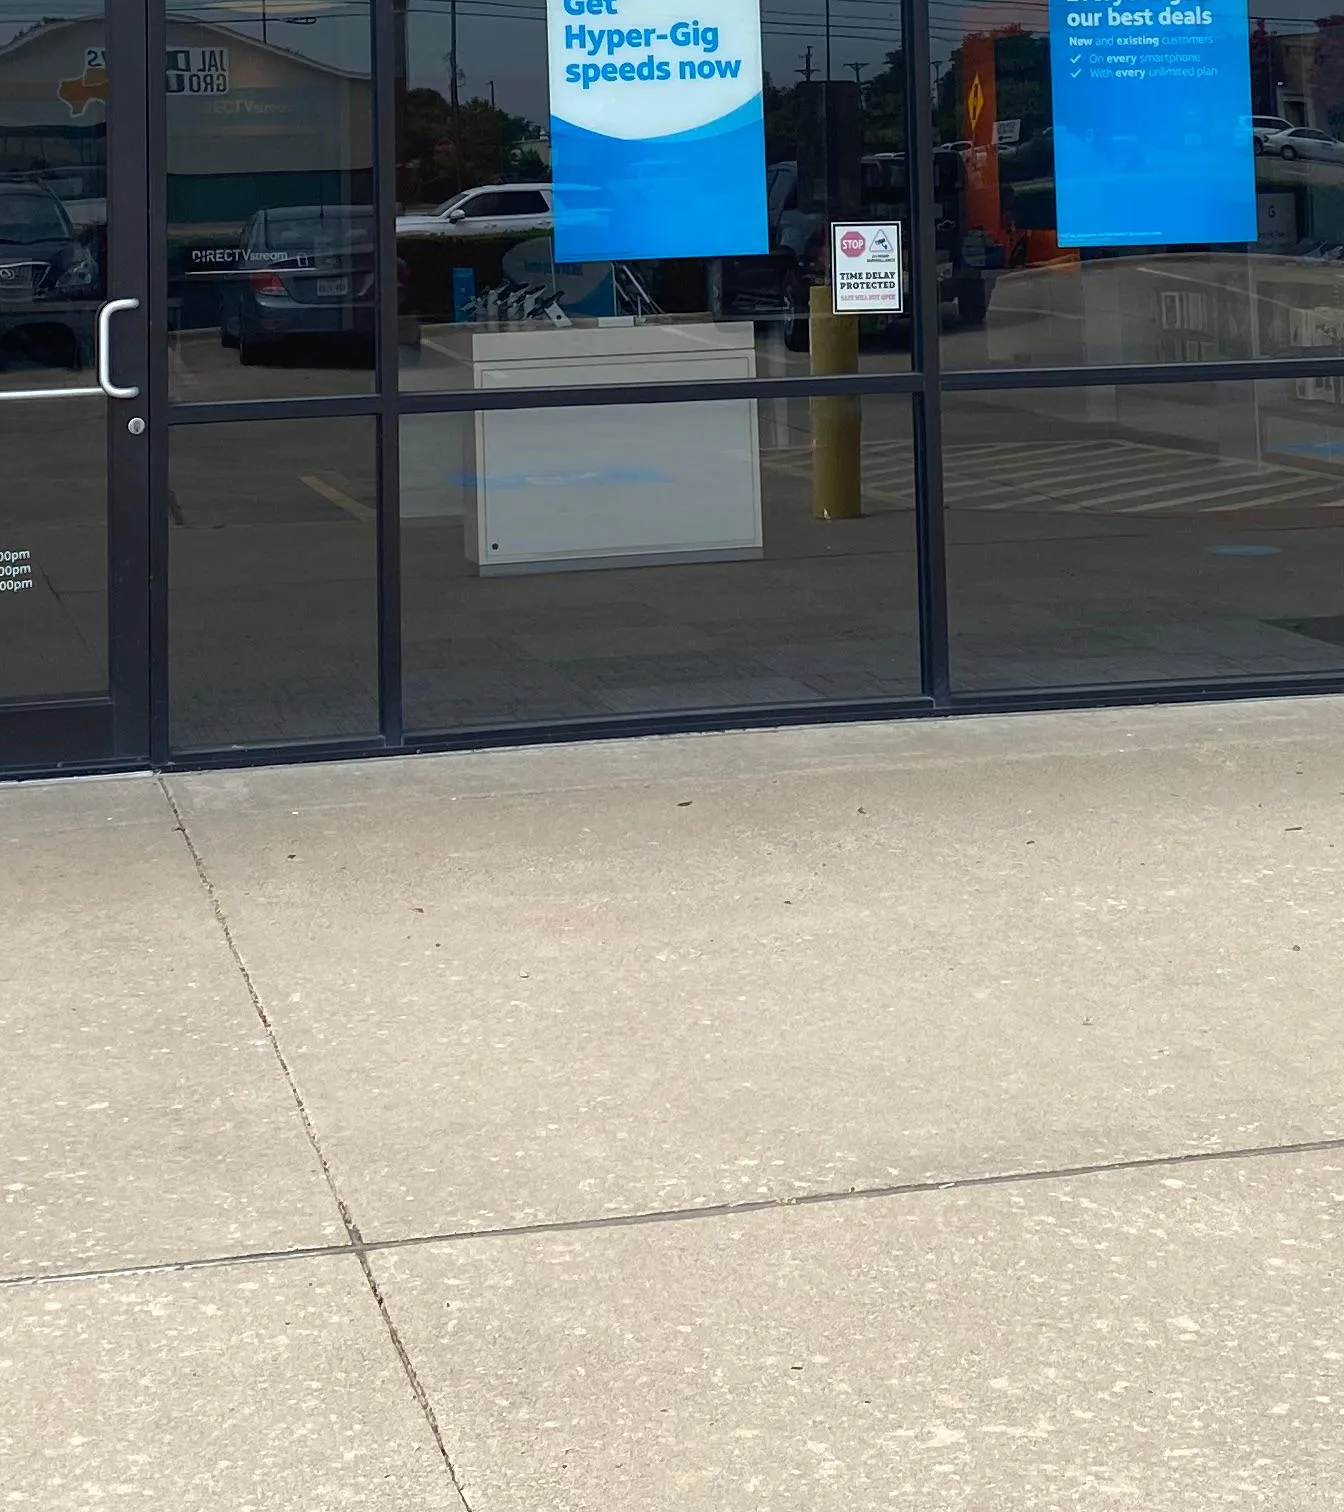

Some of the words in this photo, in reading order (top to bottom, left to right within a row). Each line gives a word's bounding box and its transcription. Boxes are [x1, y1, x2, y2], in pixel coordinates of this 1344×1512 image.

[1066, 11, 1103, 27] our
[1107, 7, 1154, 26] best
[1158, 6, 1212, 26] deals
[564, 20, 719, 57] Hyper-Gig
[1069, 37, 1093, 47] New
[1095, 36, 1114, 46] and
[1116, 35, 1159, 48] existing
[1161, 35, 1214, 45] customers
[1089, 54, 1104, 64] On
[1106, 55, 1137, 66] every
[1139, 53, 1201, 64] smartphone
[565, 54, 671, 90] speeds
[679, 59, 742, 80] now
[1090, 67, 1113, 78] With
[1115, 69, 1145, 80] every
[1149, 67, 1195, 77] unlimited
[1196, 66, 1218, 78] plan
[842, 239, 864, 250] STOP
[839, 272, 863, 280] TIME
[865, 271, 896, 280] DELAY
[839, 281, 896, 290] PROTECTED
